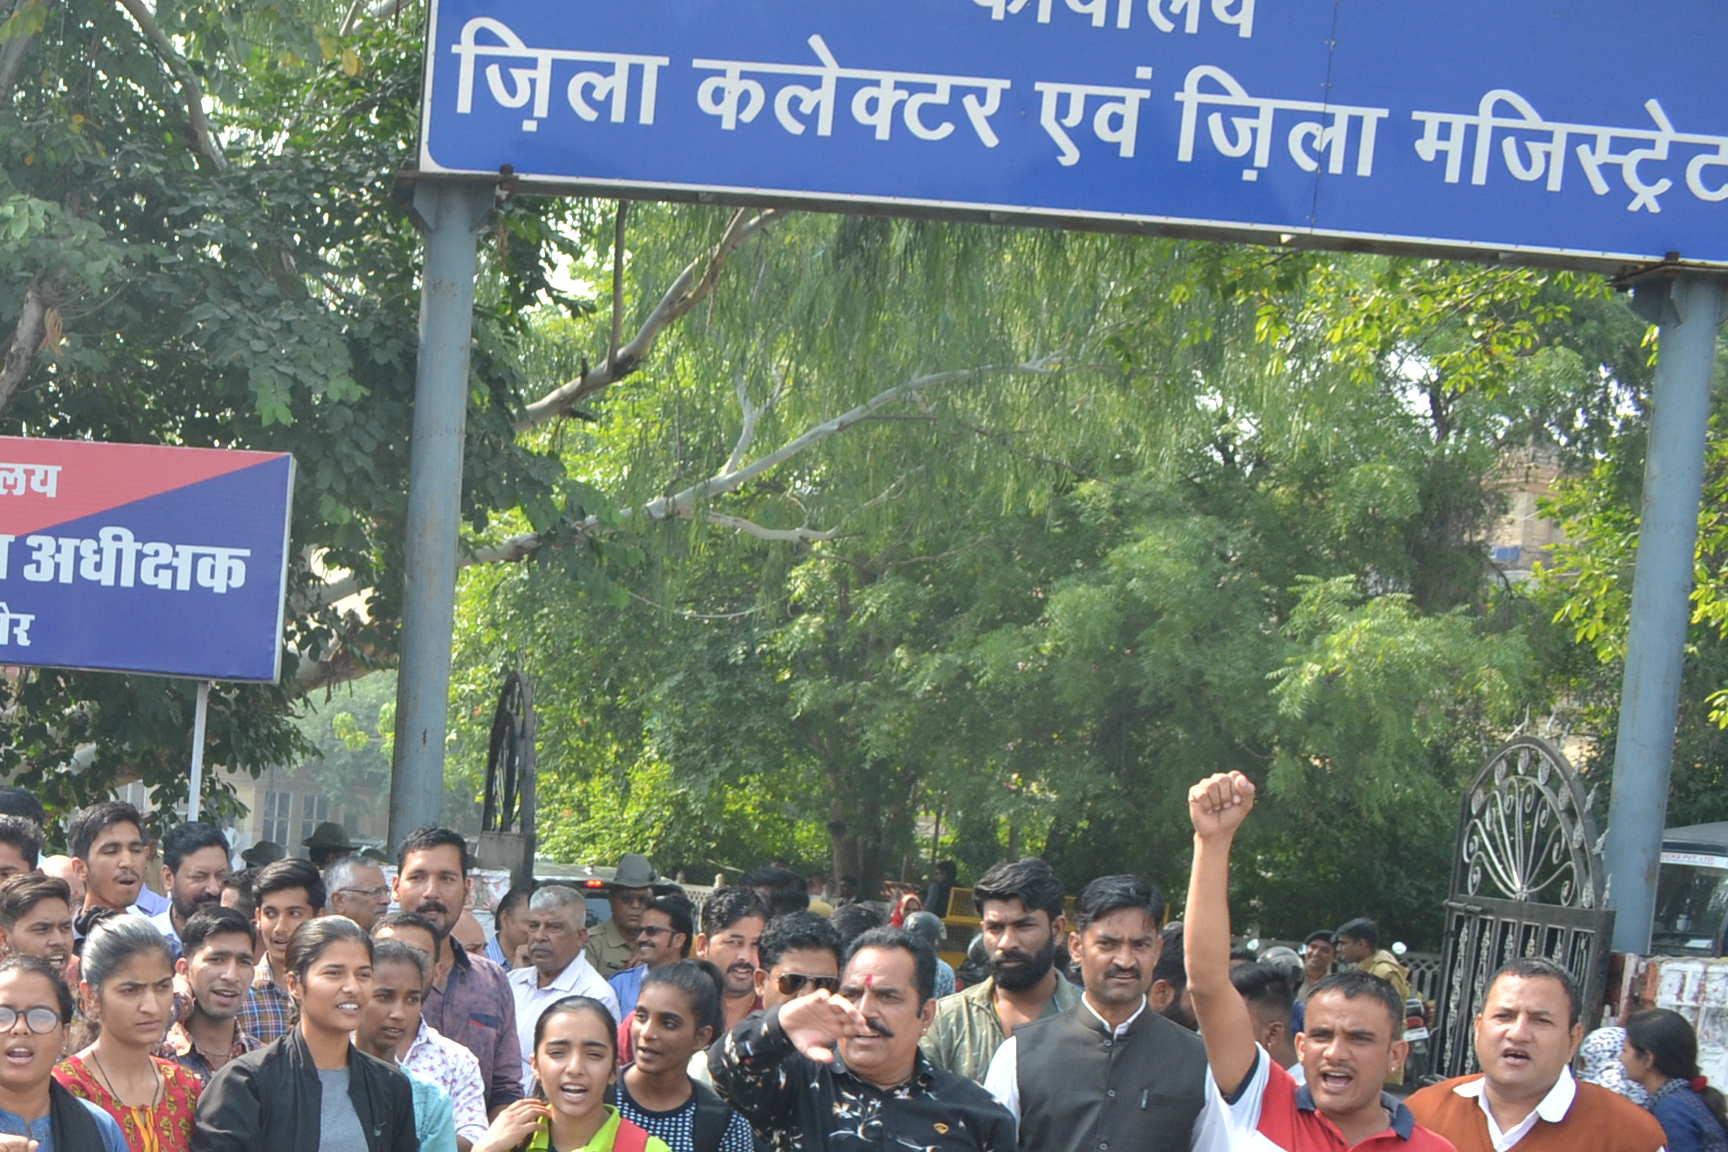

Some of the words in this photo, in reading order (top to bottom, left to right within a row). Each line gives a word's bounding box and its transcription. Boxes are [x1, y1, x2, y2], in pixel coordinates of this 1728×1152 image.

[692, 34, 1012, 148] कलेक्टर
[1034, 66, 1153, 166] एवं
[23, 526, 251, 593] अधीक्षक
